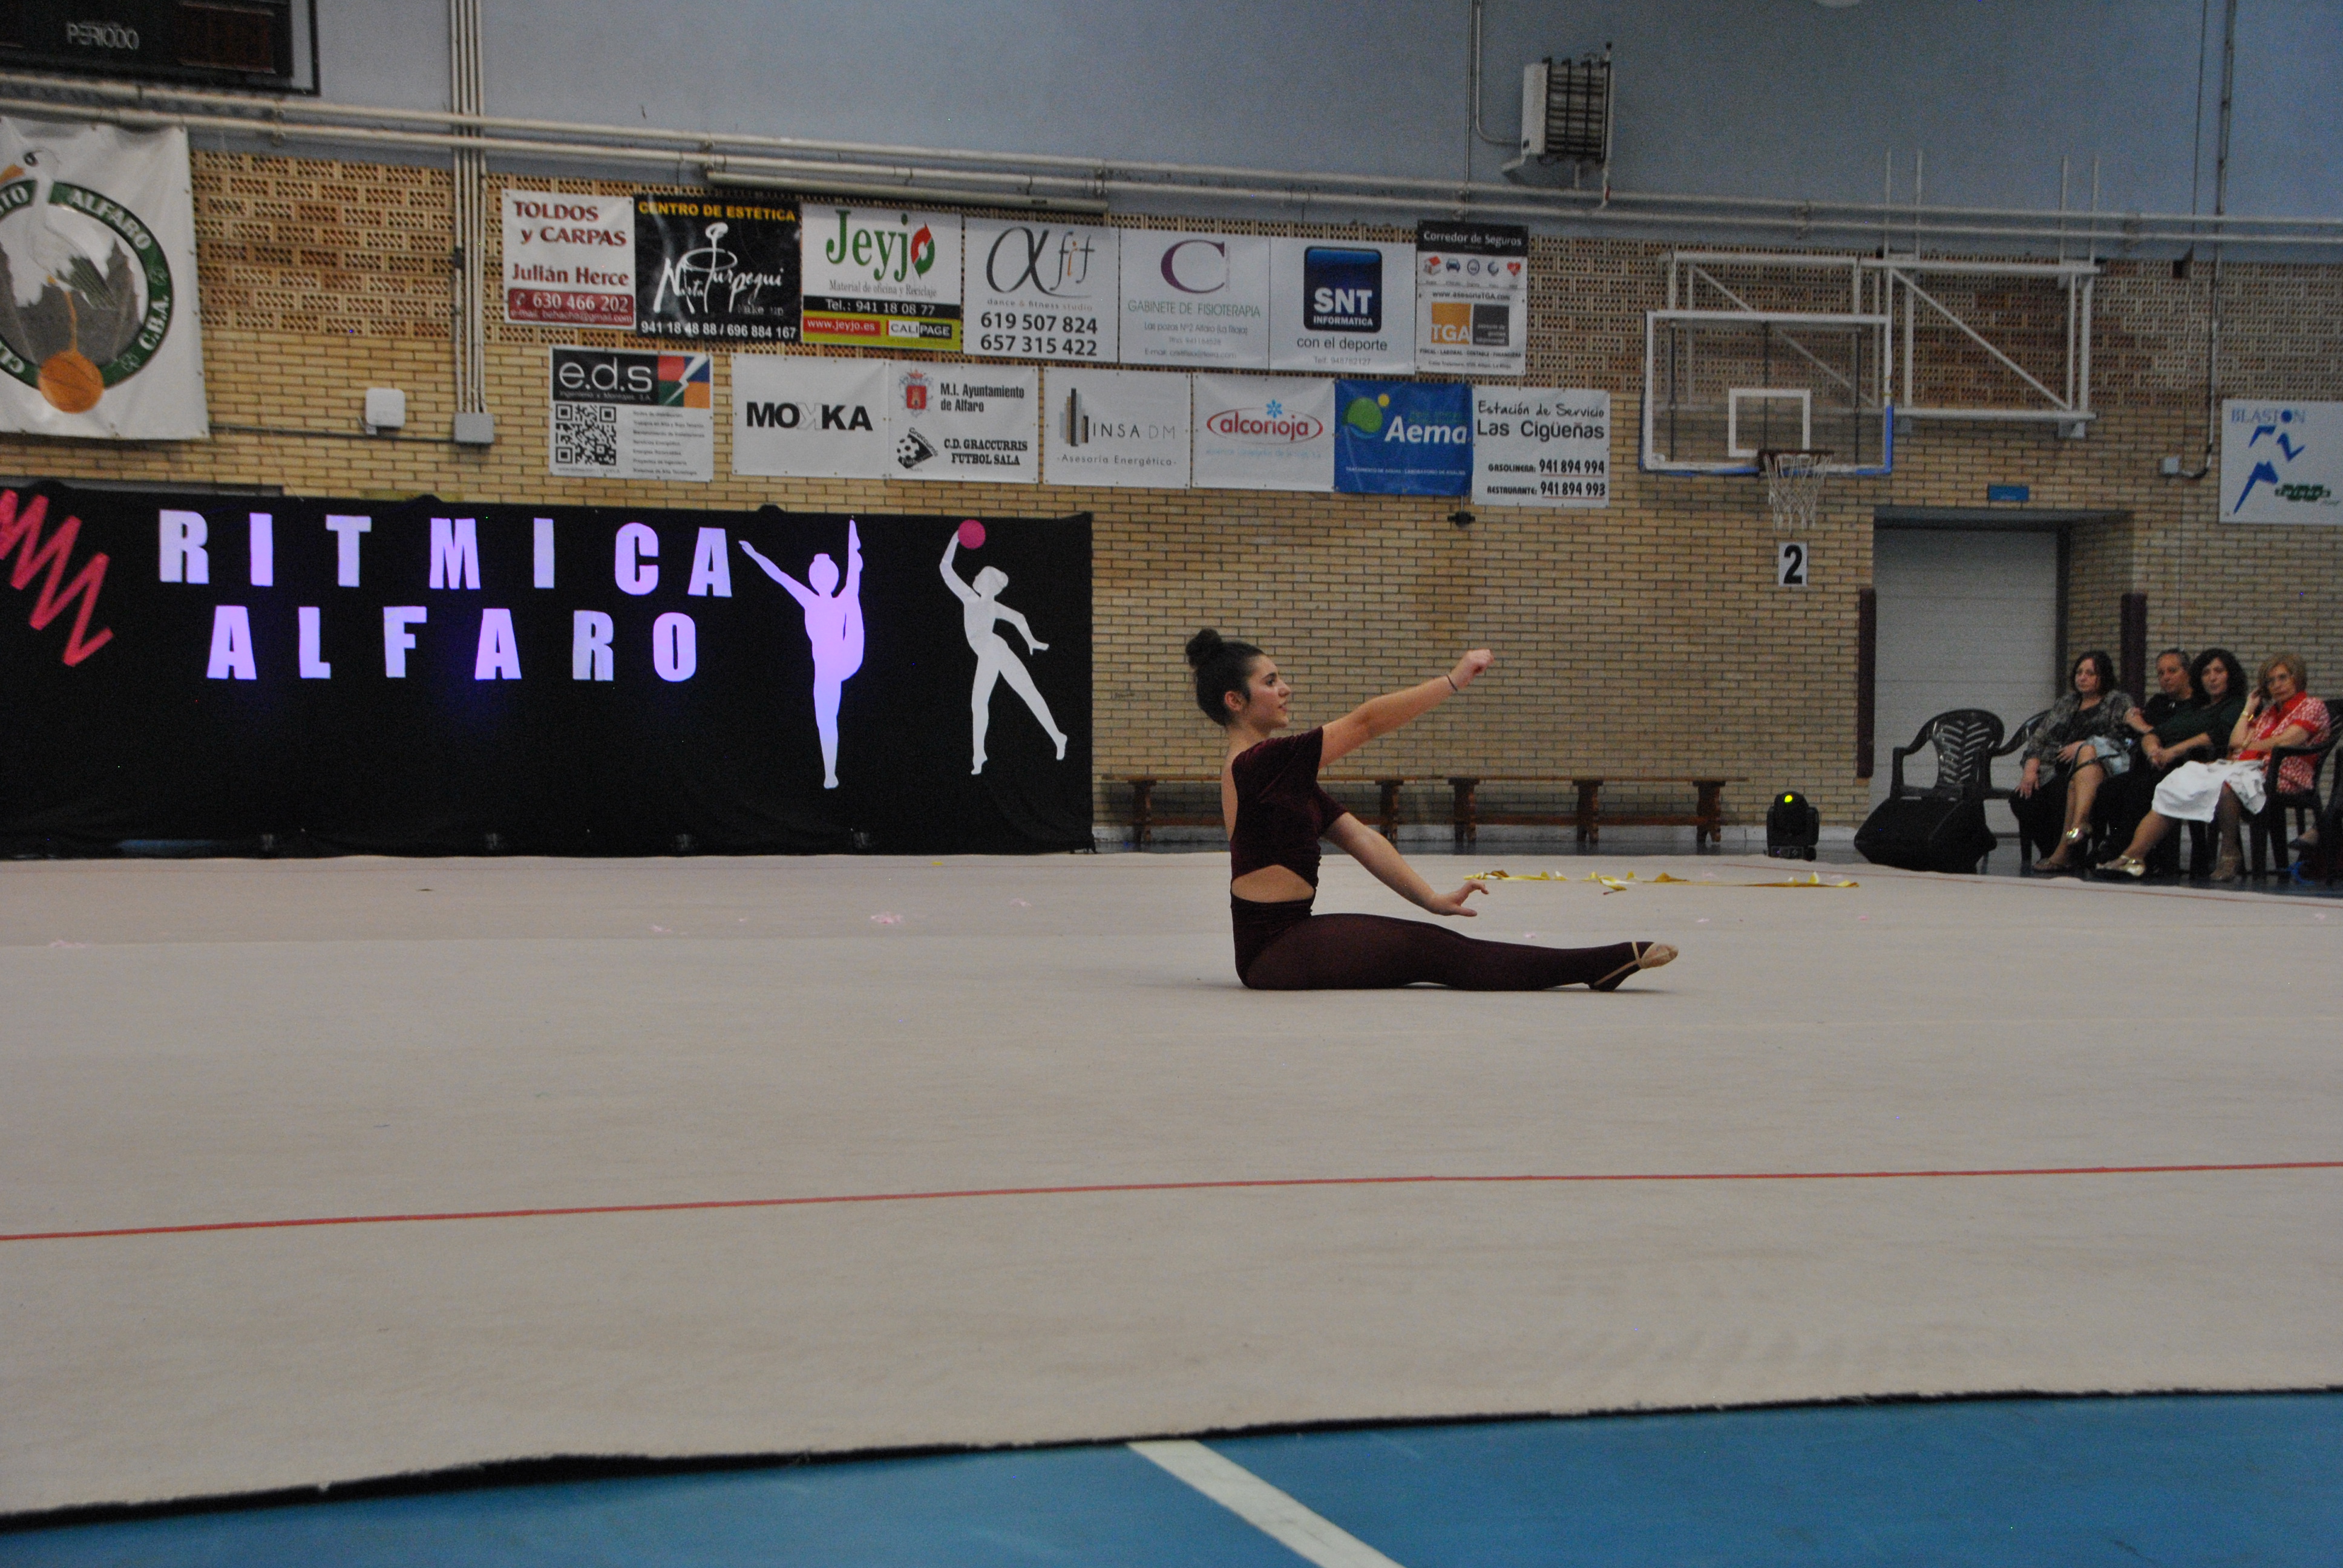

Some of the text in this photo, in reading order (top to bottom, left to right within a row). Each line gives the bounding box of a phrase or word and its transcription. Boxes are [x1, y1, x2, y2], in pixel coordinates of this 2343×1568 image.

[66, 22, 139, 50] PERIODO
[514, 200, 599, 221] TOLDOS
[639, 201, 699, 215] CENTRO
[703, 204, 723, 217] DE
[67, 189, 152, 250] ALFARO
[521, 226, 627, 246] y CARPAS
[826, 209, 935, 282] Jeyjo
[1424, 230, 1469, 243] Corredor
[1470, 232, 1482, 242] de
[1485, 234, 1522, 248] Seguros
[1161, 239, 1225, 294] C
[576, 267, 629, 286] Herce
[829, 279, 860, 293] Material
[863, 281, 872, 293] de
[873, 283, 897, 295] oficina
[906, 284, 937, 298] Reciclaje
[533, 292, 628, 312] 630 466 202
[856, 300, 877, 312] 941
[883, 302, 897, 313] 18
[902, 303, 916, 315] 08
[921, 304, 935, 316] 77
[1127, 299, 1260, 318] GABINETE DE FISIOTERAPIA
[1314, 287, 1372, 315] SNT
[641, 321, 662, 333] 941
[667, 321, 681, 333] 18
[684, 322, 699, 334] 48
[703, 322, 717, 335] 88
[727, 324, 748, 337] 696
[752, 325, 772, 338] 884
[776, 326, 796, 339] 167
[807, 318, 875, 332] www.jeyjo.es
[981, 311, 1098, 334] 619 507 824
[1313, 315, 1373, 327] INFORMATICA
[1431, 324, 1470, 342] TGA
[981, 334, 1096, 356] 657 315 422
[1297, 337, 1388, 352] con el deporte
[559, 356, 653, 393] e.d.s
[940, 382, 1024, 399] M.I. Ayuntamiento
[940, 398, 985, 412] de Alfaro
[1478, 400, 1604, 417] Estación de Servicio
[1384, 415, 1467, 444] Aema
[1477, 419, 1604, 442] Las Cigüeñas
[944, 438, 1027, 451] C.D. GRACCURRIS
[951, 452, 1020, 465] FUTBOL SALA
[1488, 459, 1604, 474] GASOLINERA: 941 894 994
[1487, 481, 1605, 497] RESTAURANTE: 941 894 993
[159, 509, 733, 598] RITMICA
[1784, 544, 1802, 584] 2
[206, 605, 698, 682] ALFARO
